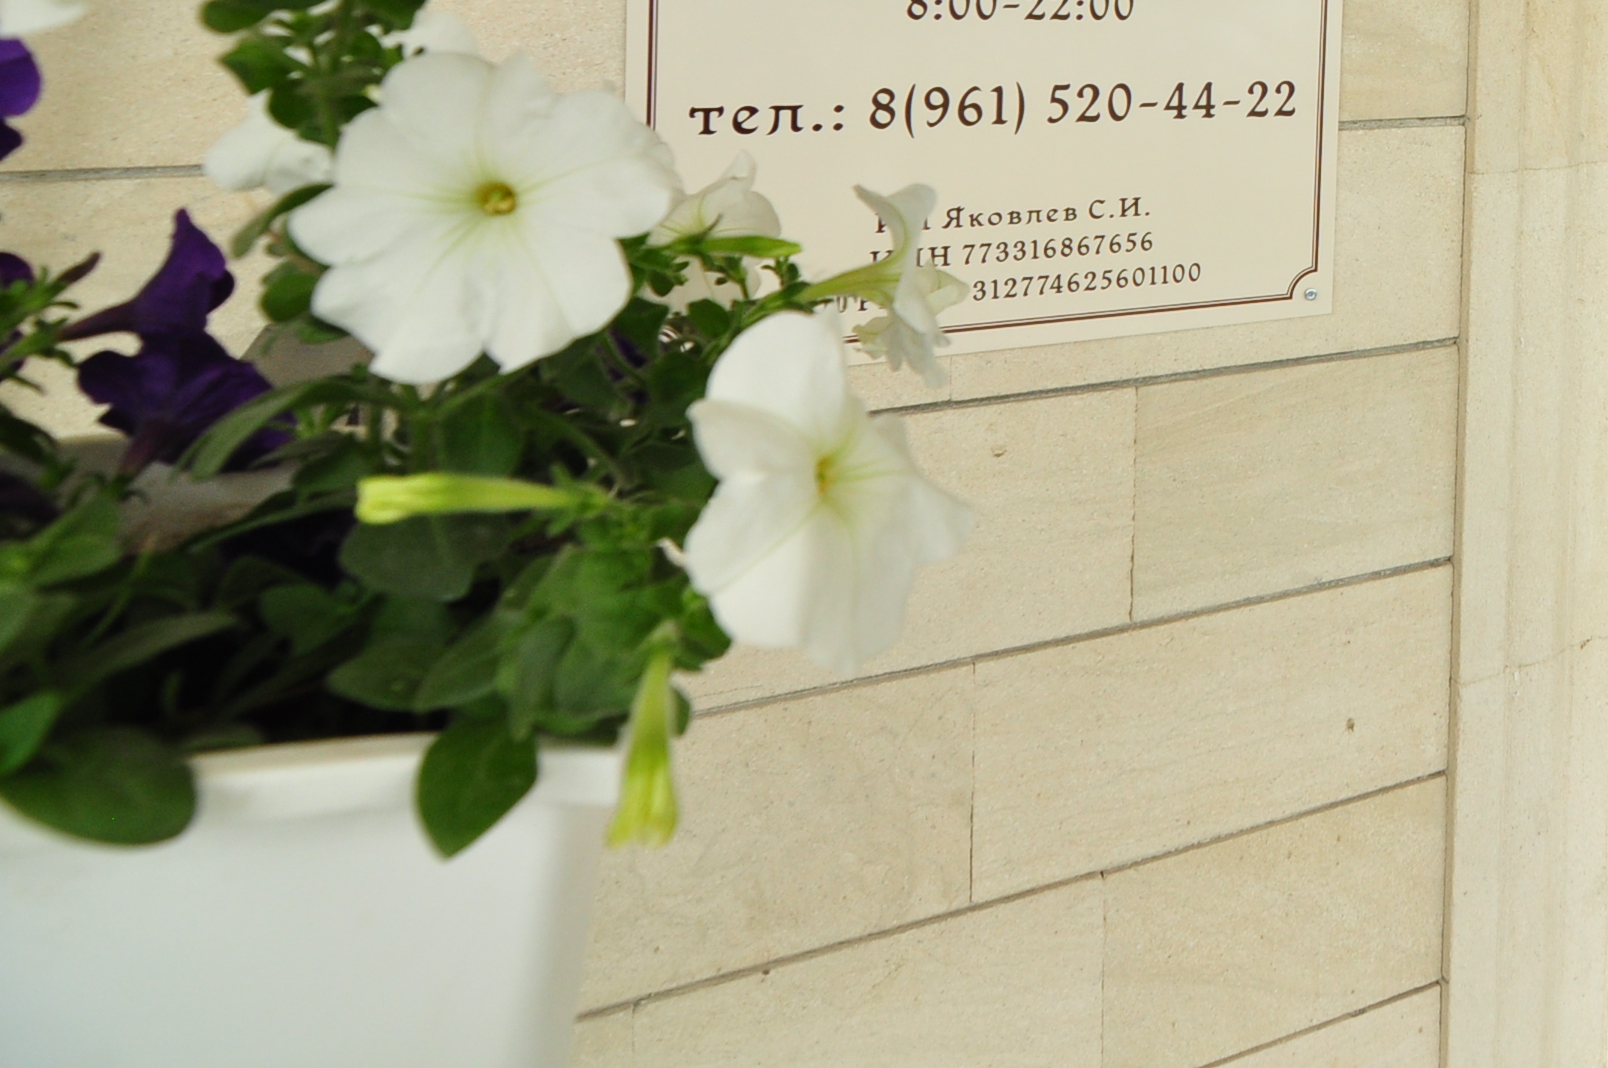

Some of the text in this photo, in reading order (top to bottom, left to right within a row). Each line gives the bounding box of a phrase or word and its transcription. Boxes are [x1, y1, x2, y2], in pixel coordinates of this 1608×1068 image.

[689, 81, 1296, 138] тел.: 8(961) 520-44-22
[941, 205, 1078, 230] Яковлев
[1088, 196, 1151, 220] С.И.
[962, 232, 1153, 266] 773316867656
[973, 263, 1201, 301] 312774625601100
